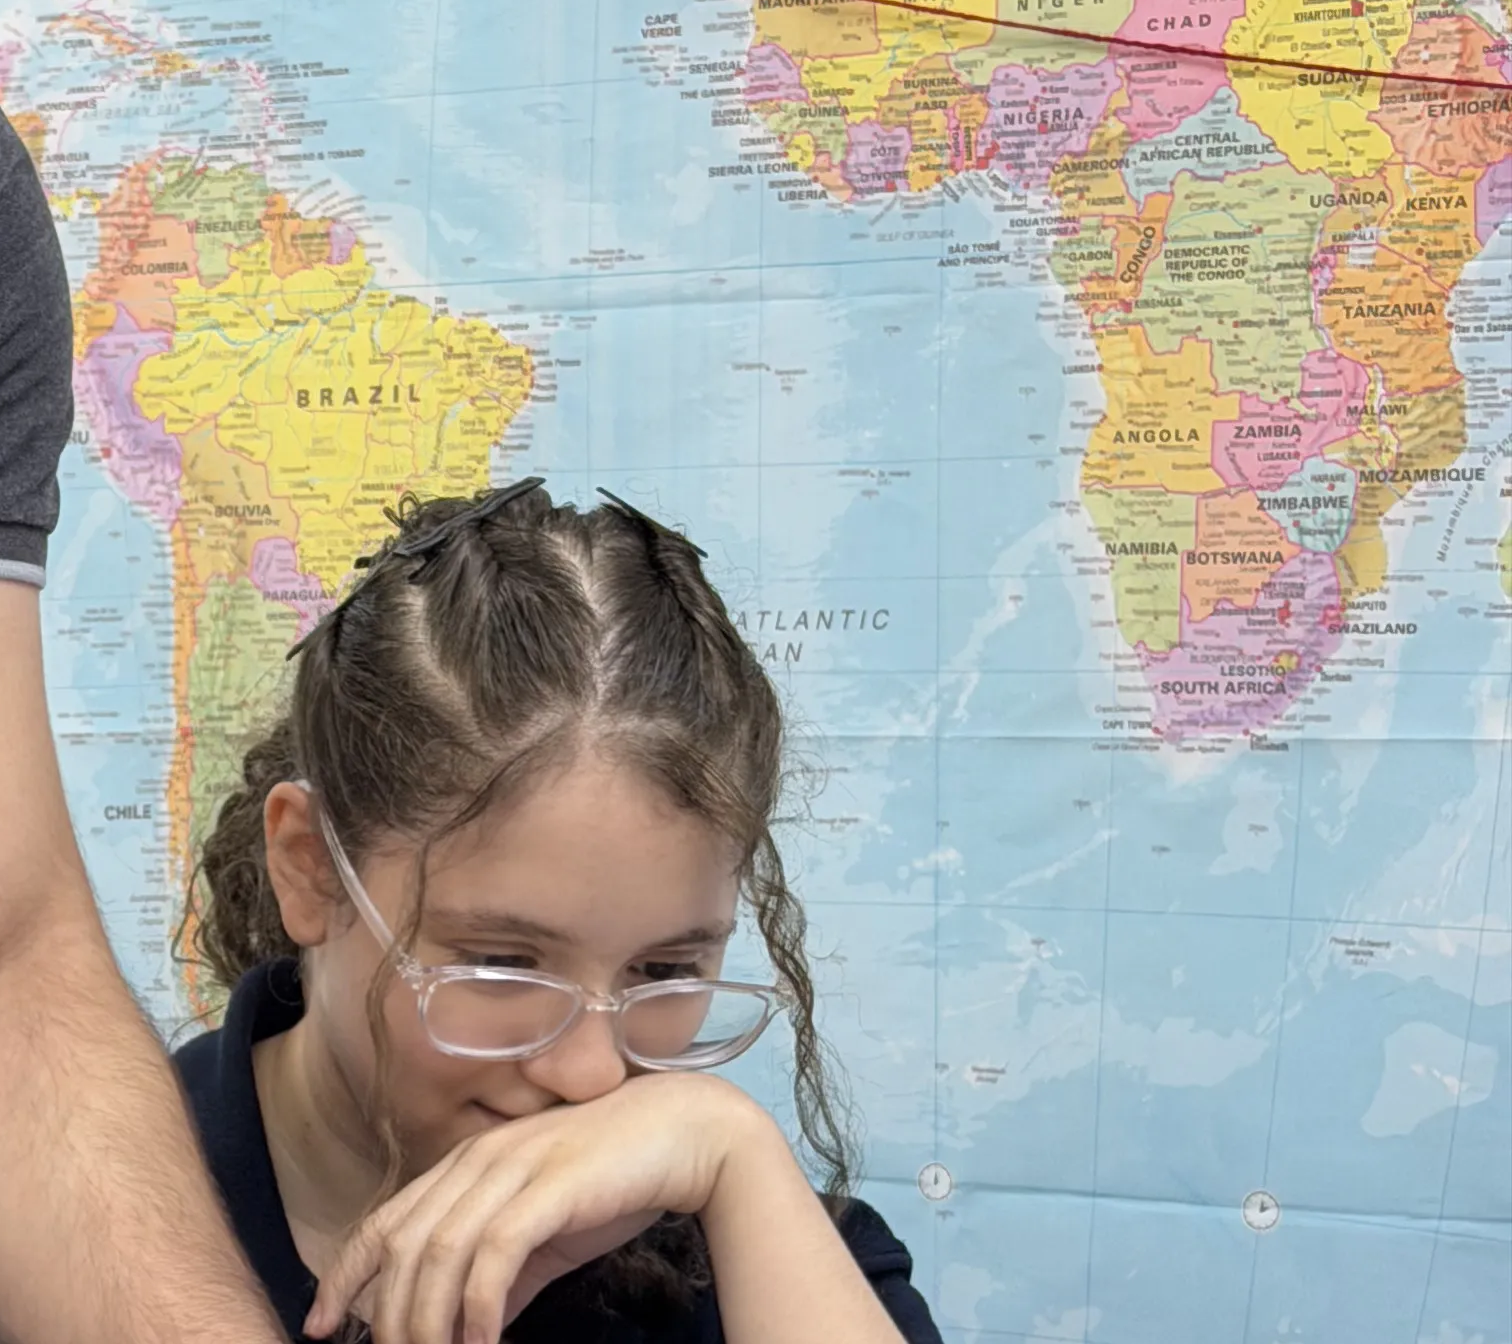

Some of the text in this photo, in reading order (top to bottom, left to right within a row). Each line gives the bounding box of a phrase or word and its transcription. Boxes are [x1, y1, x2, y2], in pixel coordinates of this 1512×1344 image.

[644, 12, 678, 26] CAPE
[1146, 14, 1213, 32] CHAD
[1294, 8, 1351, 23] KHARTOUM
[641, 25, 682, 39] VERDE
[903, 75, 958, 90] BURKINA
[1297, 71, 1361, 87] SUDAN
[798, 105, 851, 120] GUINEA
[1004, 106, 1085, 126] NIGERIA
[1428, 99, 1512, 118] ETHIOPIA
[1175, 131, 1242, 146] CENTRAL
[1139, 142, 1276, 164] AFRICAN REPUBLIC
[708, 160, 799, 178] SIERRA LEONE
[1052, 156, 1130, 173] CAMEROON
[777, 187, 829, 202] LIBERIA
[1309, 191, 1389, 208] UGANDA
[1406, 195, 1468, 211] KENYA
[187, 218, 263, 235] VENEZUELA
[1068, 250, 1114, 263] GABON
[1120, 225, 1157, 284] CONGO
[1164, 244, 1251, 259] DEMOCRATIC
[121, 261, 189, 276] COLOMBIA
[1165, 257, 1249, 272] REPUBLIC OF
[1169, 268, 1245, 283] THE CONGO
[1343, 301, 1436, 319] TANZANIA
[296, 383, 422, 408] BRAZIL
[1346, 403, 1408, 418] MALAWI
[1113, 427, 1200, 445] ANGOLA
[1233, 423, 1303, 441] ZAMBIA
[1358, 466, 1486, 484] MOZAMBIQUE
[214, 503, 273, 518] BOLIVIA
[1256, 494, 1350, 512] ZIMBABWE
[1105, 539, 1179, 557] NAMIBIA
[1186, 549, 1286, 566] BOTSWANA
[263, 589, 336, 603] PARAGUAY
[735, 608, 890, 632] ATLANTIC
[1327, 621, 1419, 637] SWAZILAND
[1220, 664, 1287, 678] LESOTHO
[1161, 679, 1288, 697] SOUTH AFRICA
[104, 803, 153, 821] CHILE
